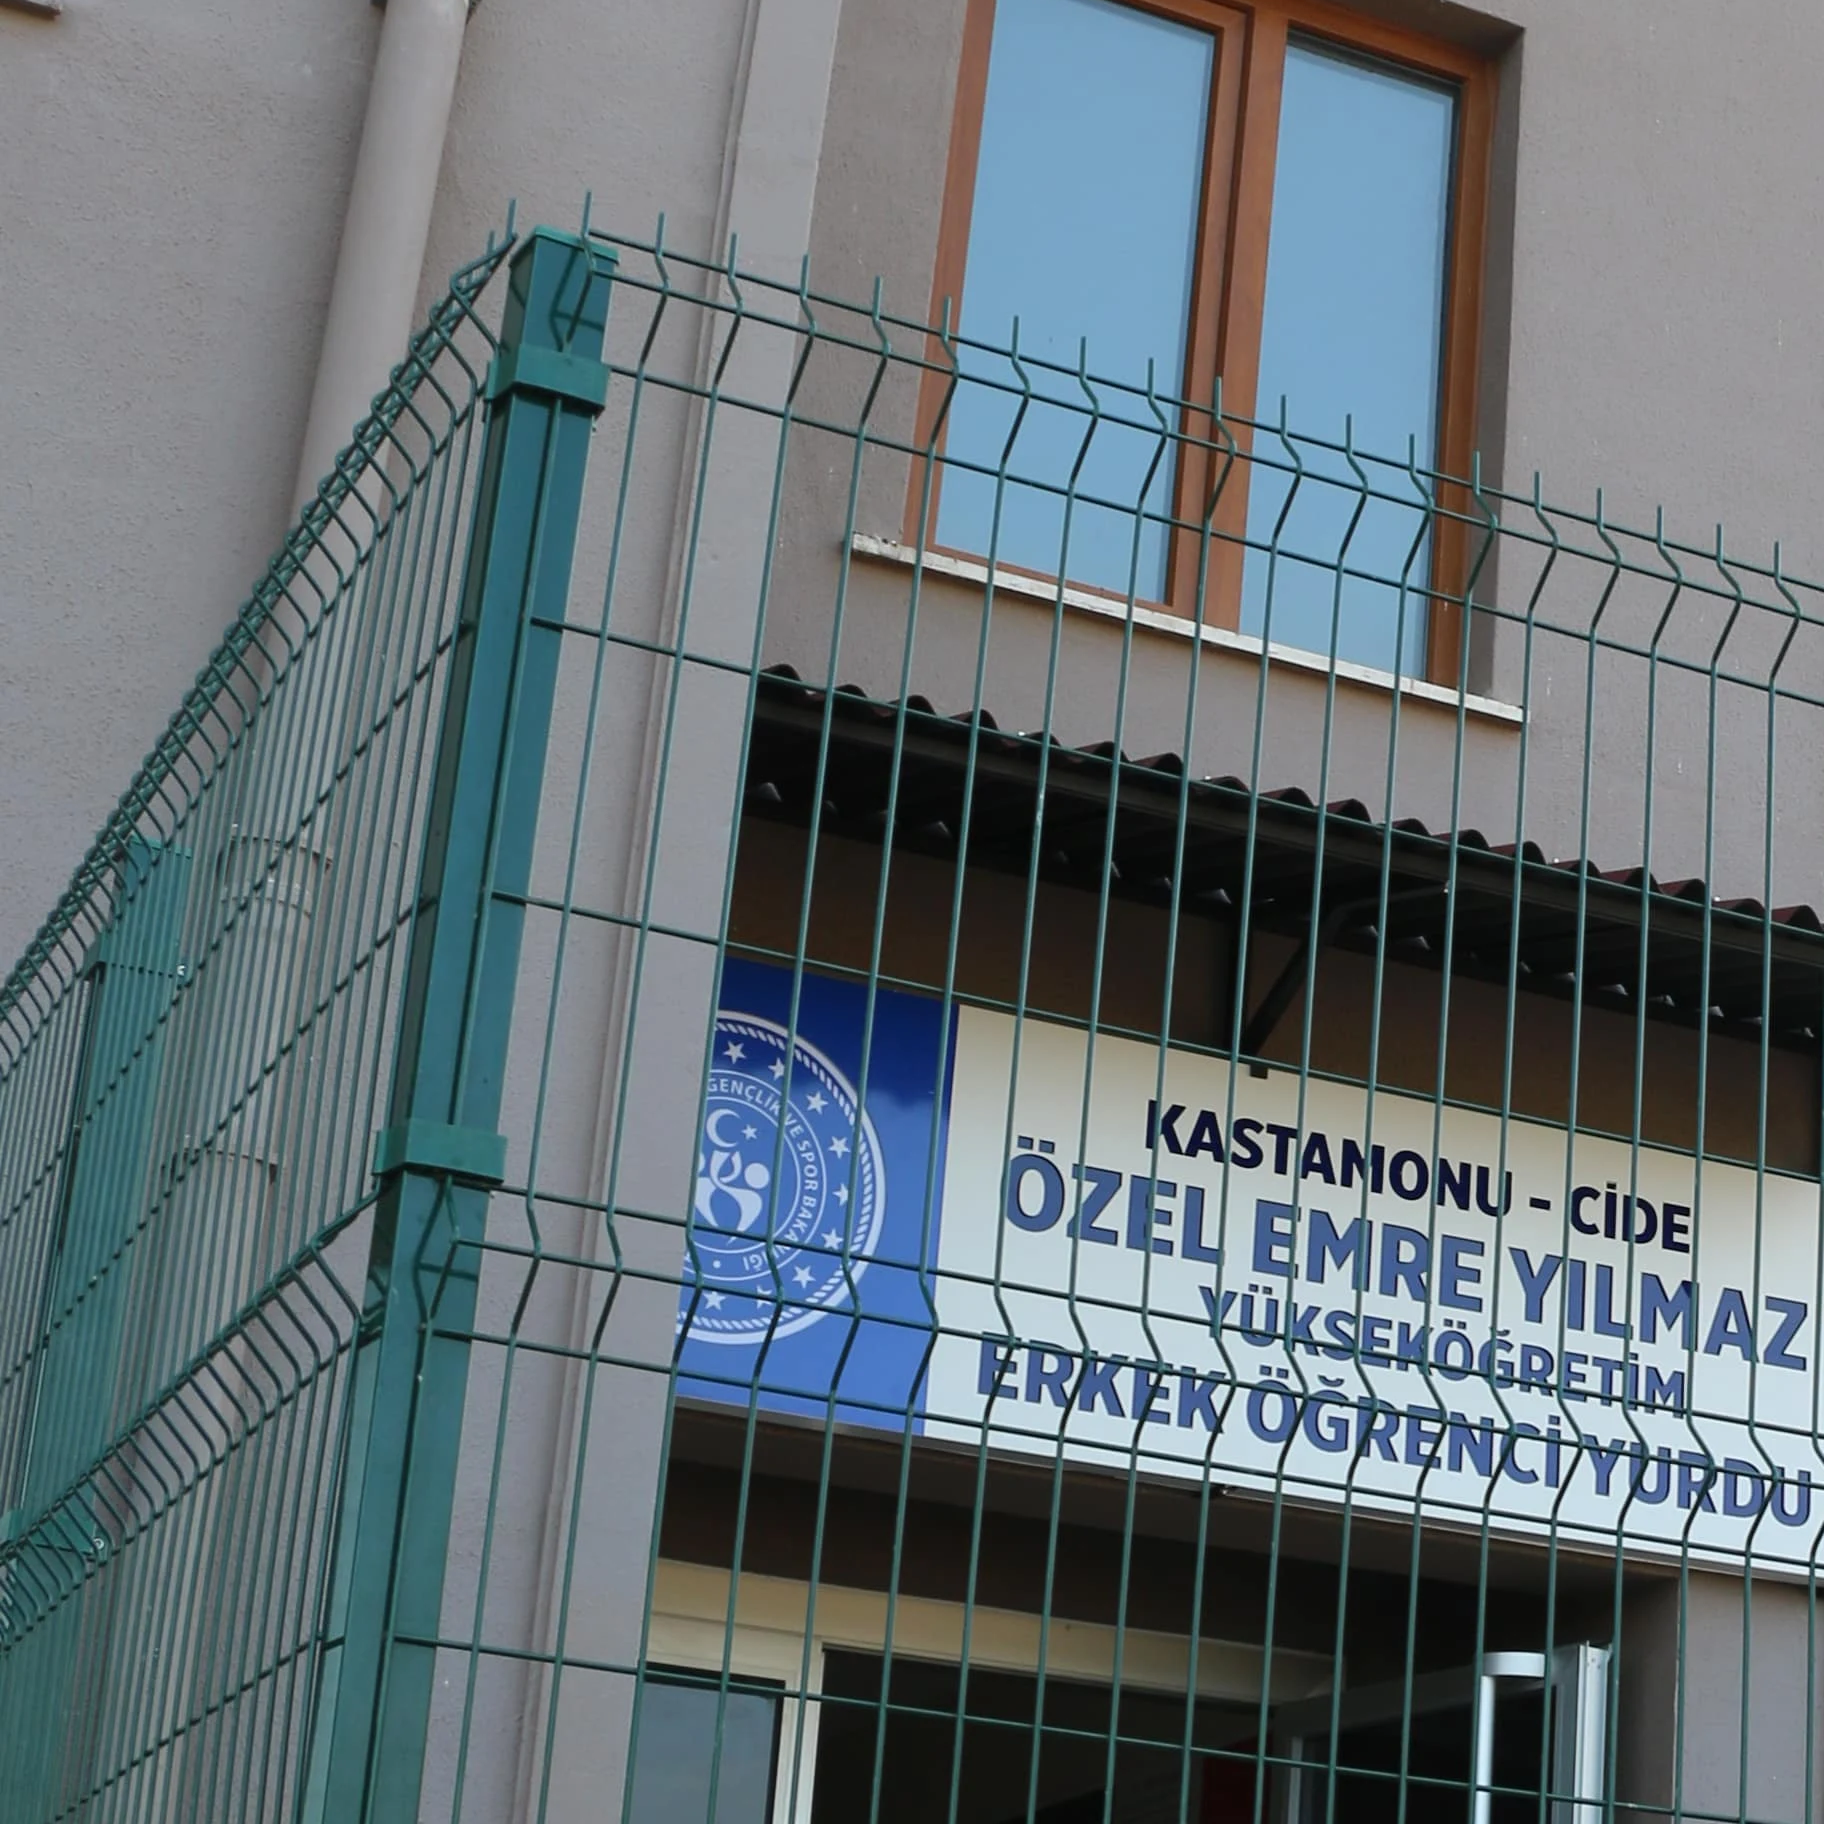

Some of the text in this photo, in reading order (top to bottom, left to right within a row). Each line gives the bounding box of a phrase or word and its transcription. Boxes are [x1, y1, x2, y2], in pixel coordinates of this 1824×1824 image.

[706, 1077, 784, 1118] GENÇLİK
[783, 1113, 805, 1138] VE
[797, 1139, 819, 1191] SPOR
[1145, 1099, 1513, 1217] KASTAMONU
[1570, 1182, 1691, 1254] CİDE
[1006, 1135, 1809, 1372] ÖZEL EMRE YILMAZ
[1199, 1283, 1685, 1419] YÜKSEKÖĞRETİM
[977, 1330, 1811, 1528] ERKEK ÖĞRENCİ YURDU
